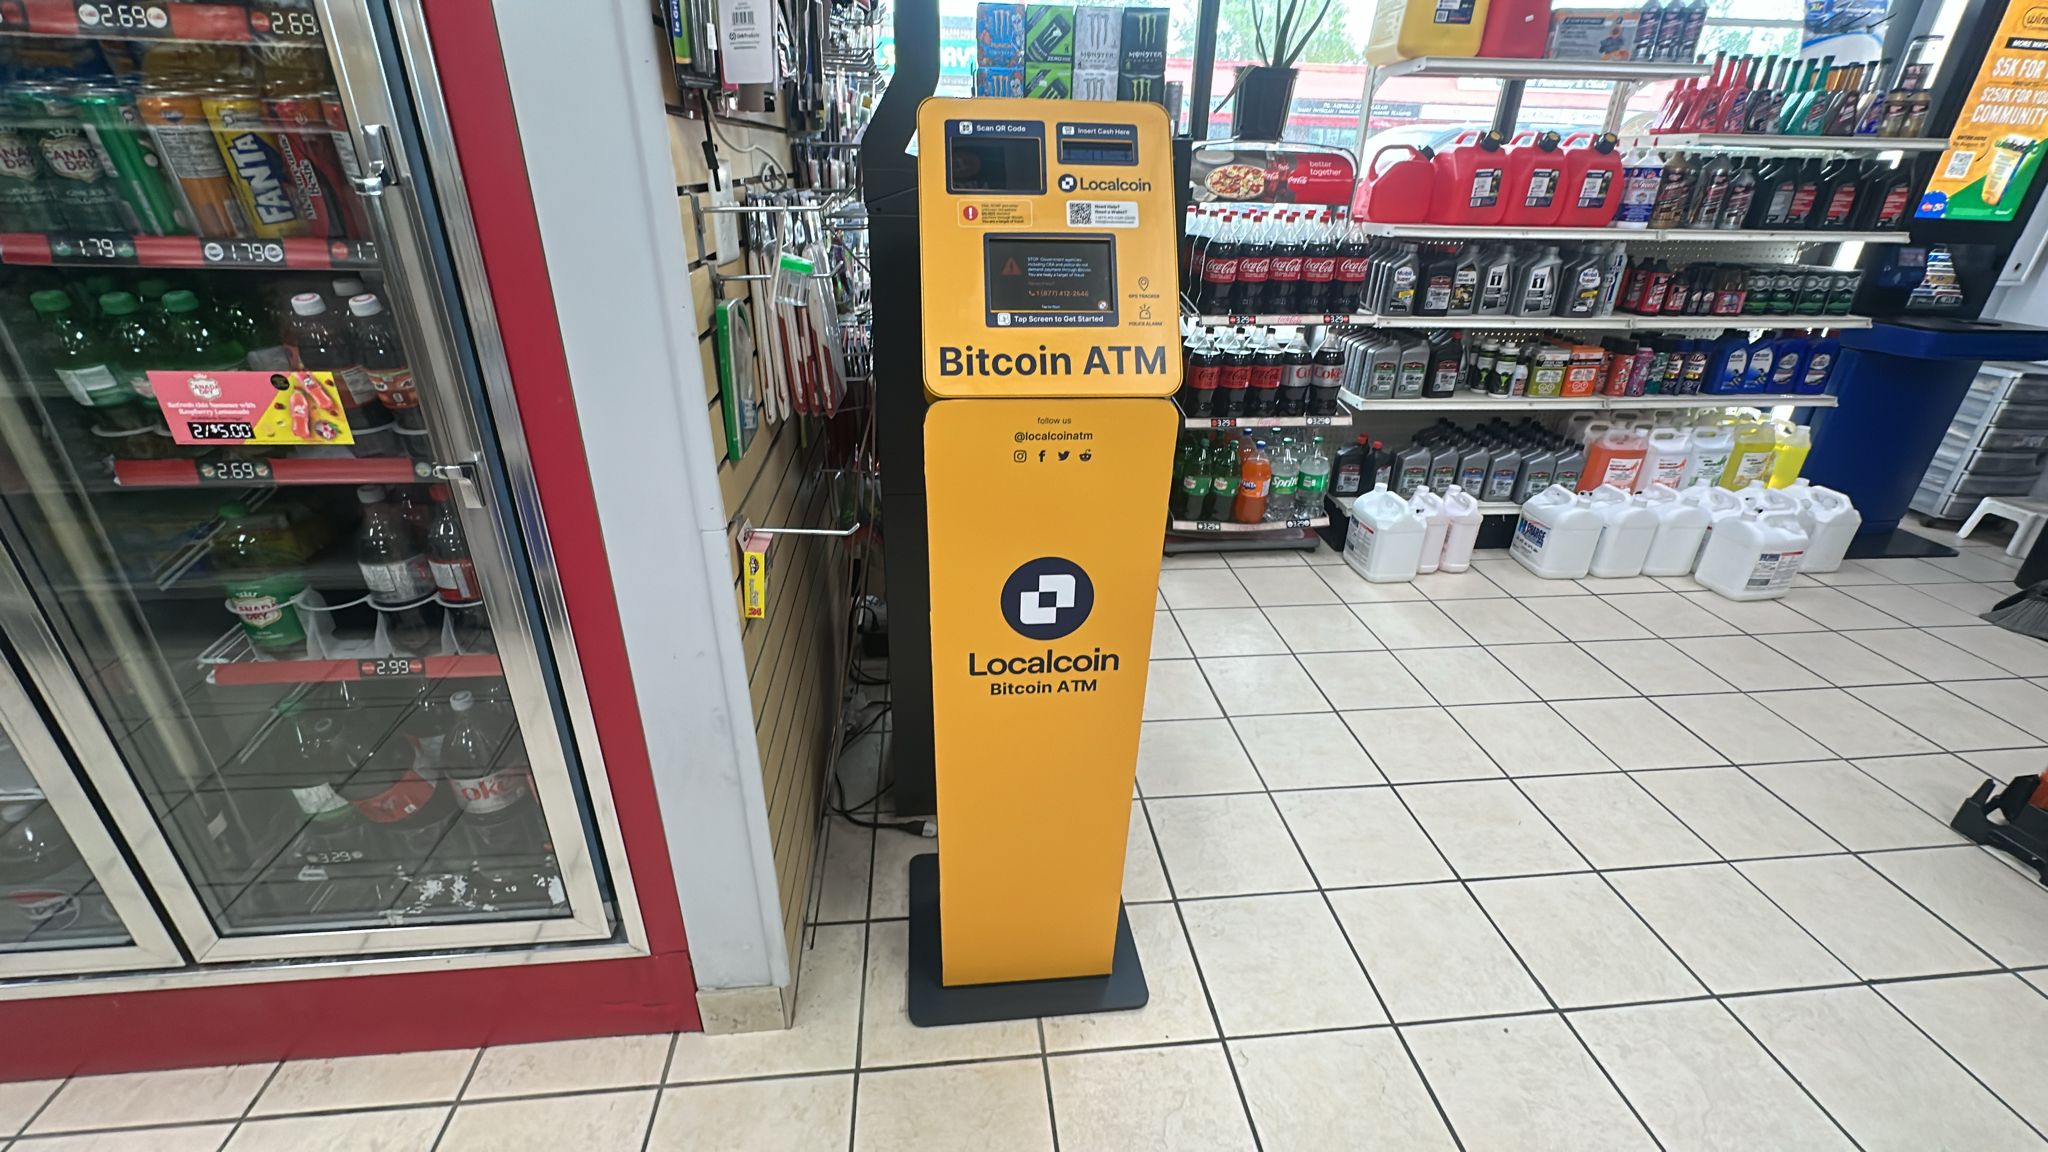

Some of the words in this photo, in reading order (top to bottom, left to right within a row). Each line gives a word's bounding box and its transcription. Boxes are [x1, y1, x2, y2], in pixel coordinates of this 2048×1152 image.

[100, 5, 149, 28] 2.69
[271, 11, 317, 36] 2.69
[1128, 49, 1163, 58] MONSTER
[1992, 56, 2021, 78] $5K
[2018, 58, 2046, 80] FOR
[2010, 88, 2033, 104] FOR
[1970, 104, 2048, 126] COMMUNITY
[1077, 127, 1096, 135] Insert
[1309, 160, 1332, 169] better
[229, 133, 296, 224] FANTA
[1310, 168, 1342, 178] together
[1080, 177, 1152, 192] Localcoin
[78, 238, 115, 258] 1.79
[231, 243, 265, 262] 1.79
[1013, 315, 1028, 324] Tap
[1029, 315, 1053, 323] Screen
[1055, 315, 1063, 323] to
[1063, 315, 1076, 323] Get
[1077, 315, 1104, 323] Started
[1236, 315, 1250, 323] 3.29
[1330, 315, 1344, 323] 3.29
[939, 344, 1072, 376] Bitcoin
[1083, 345, 1167, 376] ATM
[1314, 366, 1343, 381] Coke
[167, 401, 195, 409] Refresh
[1037, 416, 1061, 425] follow
[1062, 417, 1072, 425] us
[1217, 418, 1231, 427] 3.29
[1312, 417, 1325, 425] 3.29
[192, 424, 252, 438] 2/$5.00
[1014, 431, 1093, 443] @localcoinatm
[216, 462, 254, 479] 2.69
[1203, 522, 1216, 531] 3.29
[1292, 519, 1306, 527] 3.29
[376, 659, 409, 675] 2.99
[968, 647, 1120, 677] Localcoin
[990, 680, 1052, 696] Bitcoin
[1057, 679, 1097, 693] ATM
[319, 851, 351, 863] 3.29
